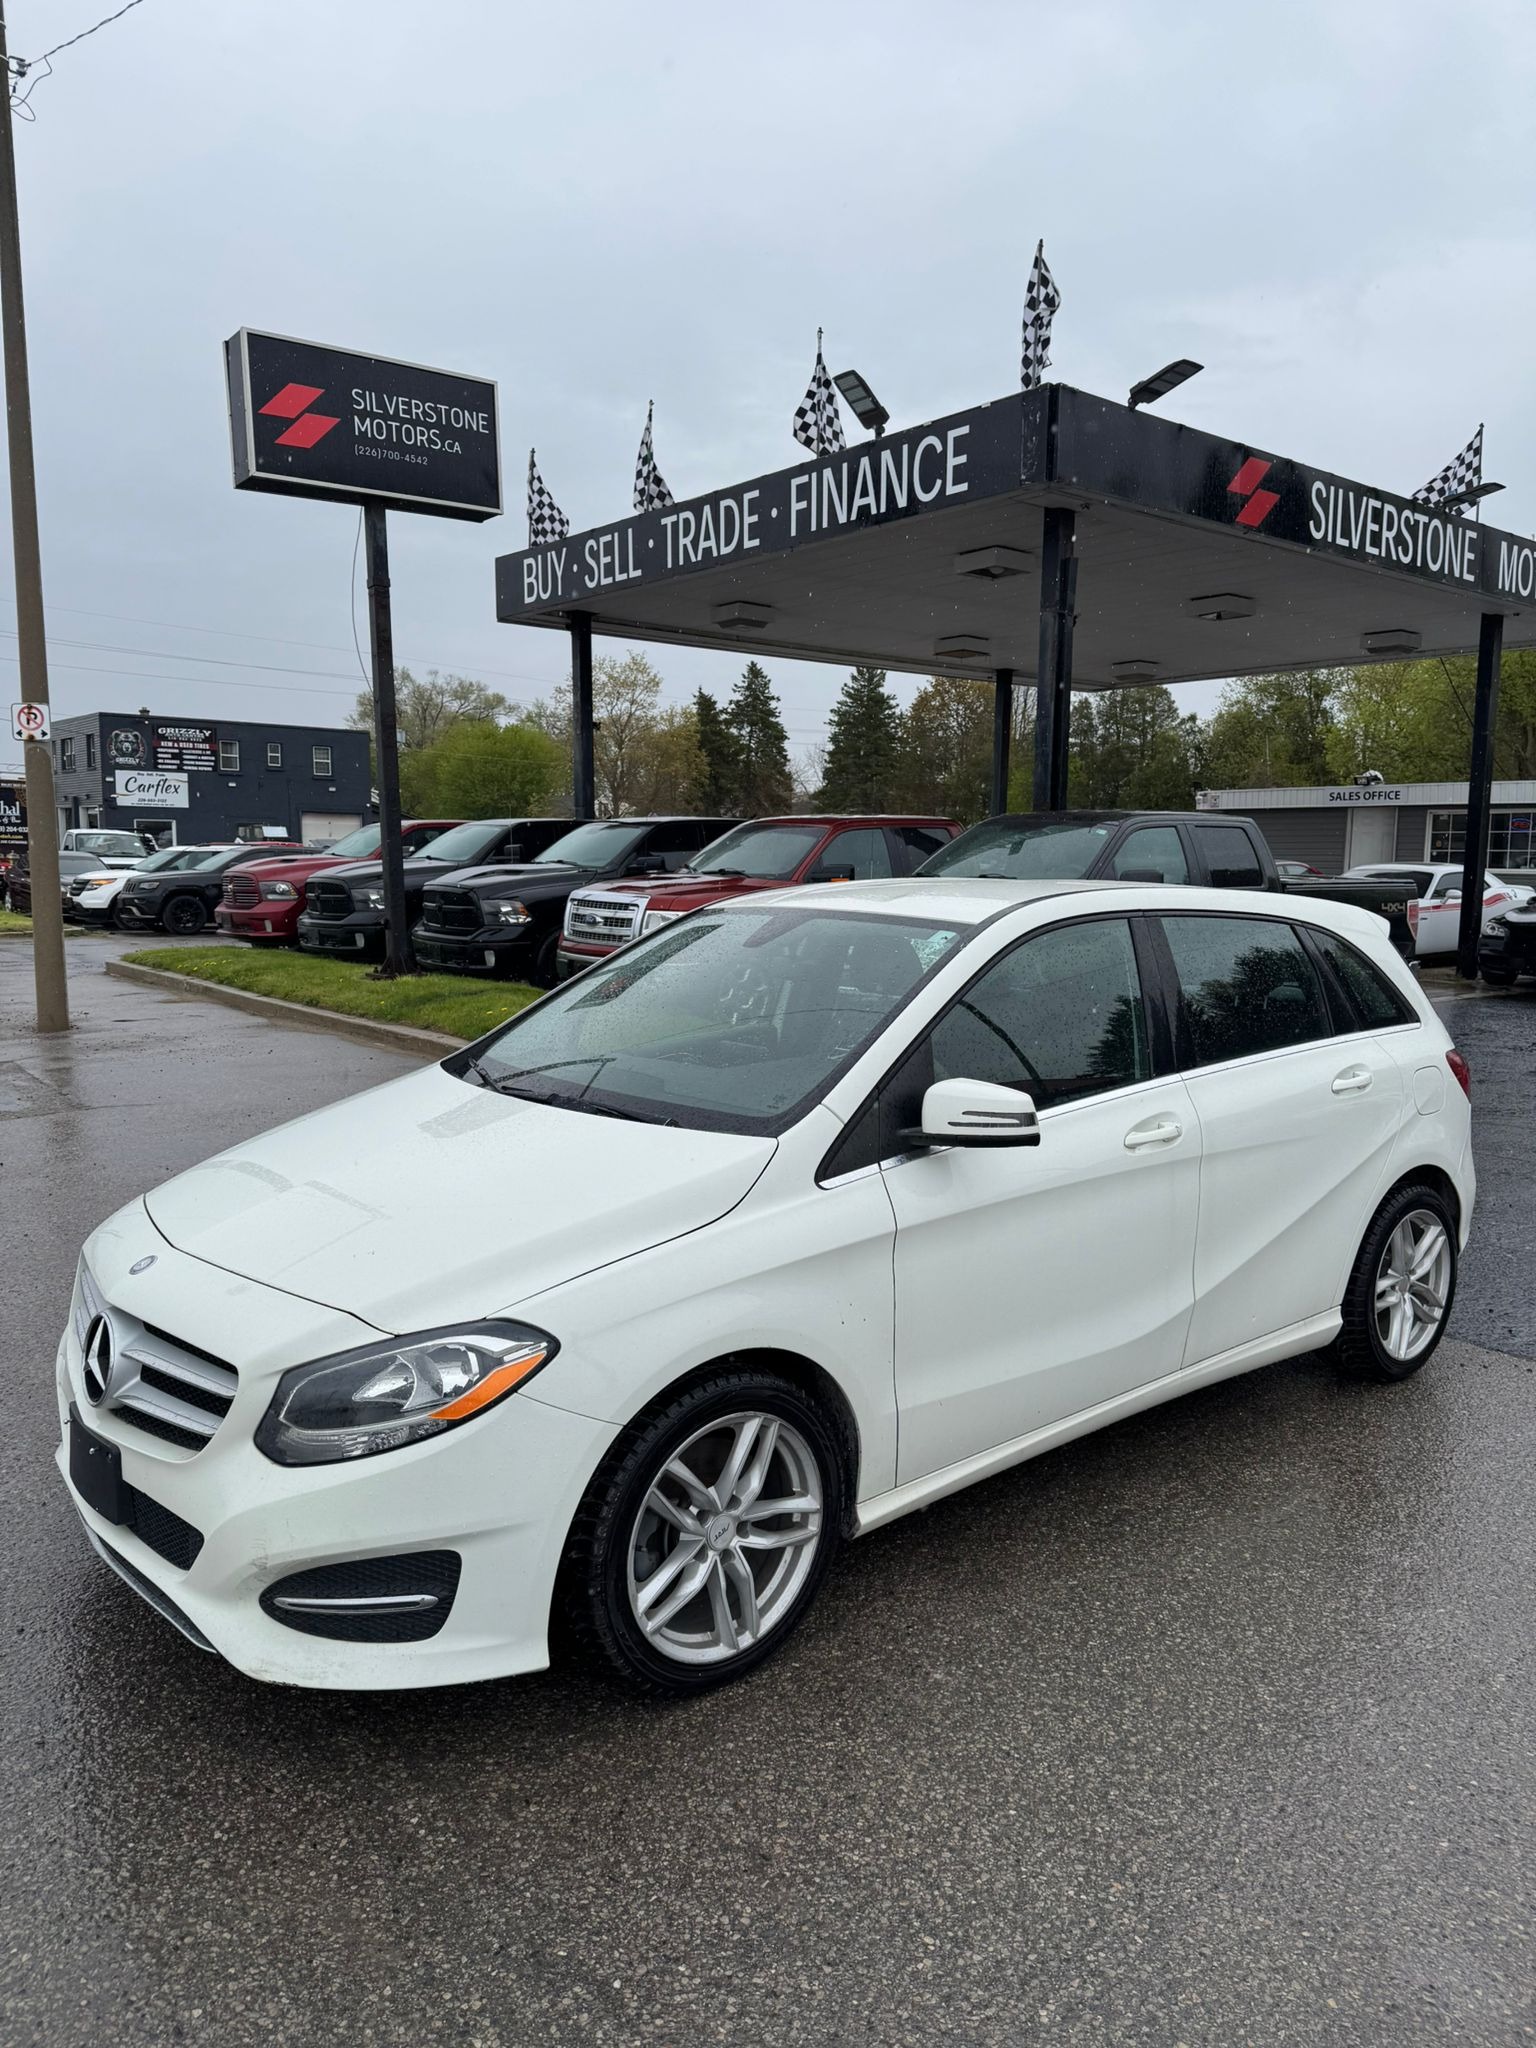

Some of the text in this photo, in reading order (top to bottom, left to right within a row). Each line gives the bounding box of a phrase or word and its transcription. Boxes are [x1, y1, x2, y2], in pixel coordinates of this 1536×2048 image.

[351, 388, 490, 434] SILVERSTONE
[353, 415, 462, 455] MOTORS.CA
[354, 444, 428, 466] (226)700-4542
[523, 424, 970, 604] BUY SELL TRADE FINANCE
[1308, 480, 1536, 599] SILVERSTONE MO
[158, 727, 212, 737] GRIZZLY
[125, 776, 181, 797] Carflex
[1329, 790, 1401, 801] SALES OFFICE
